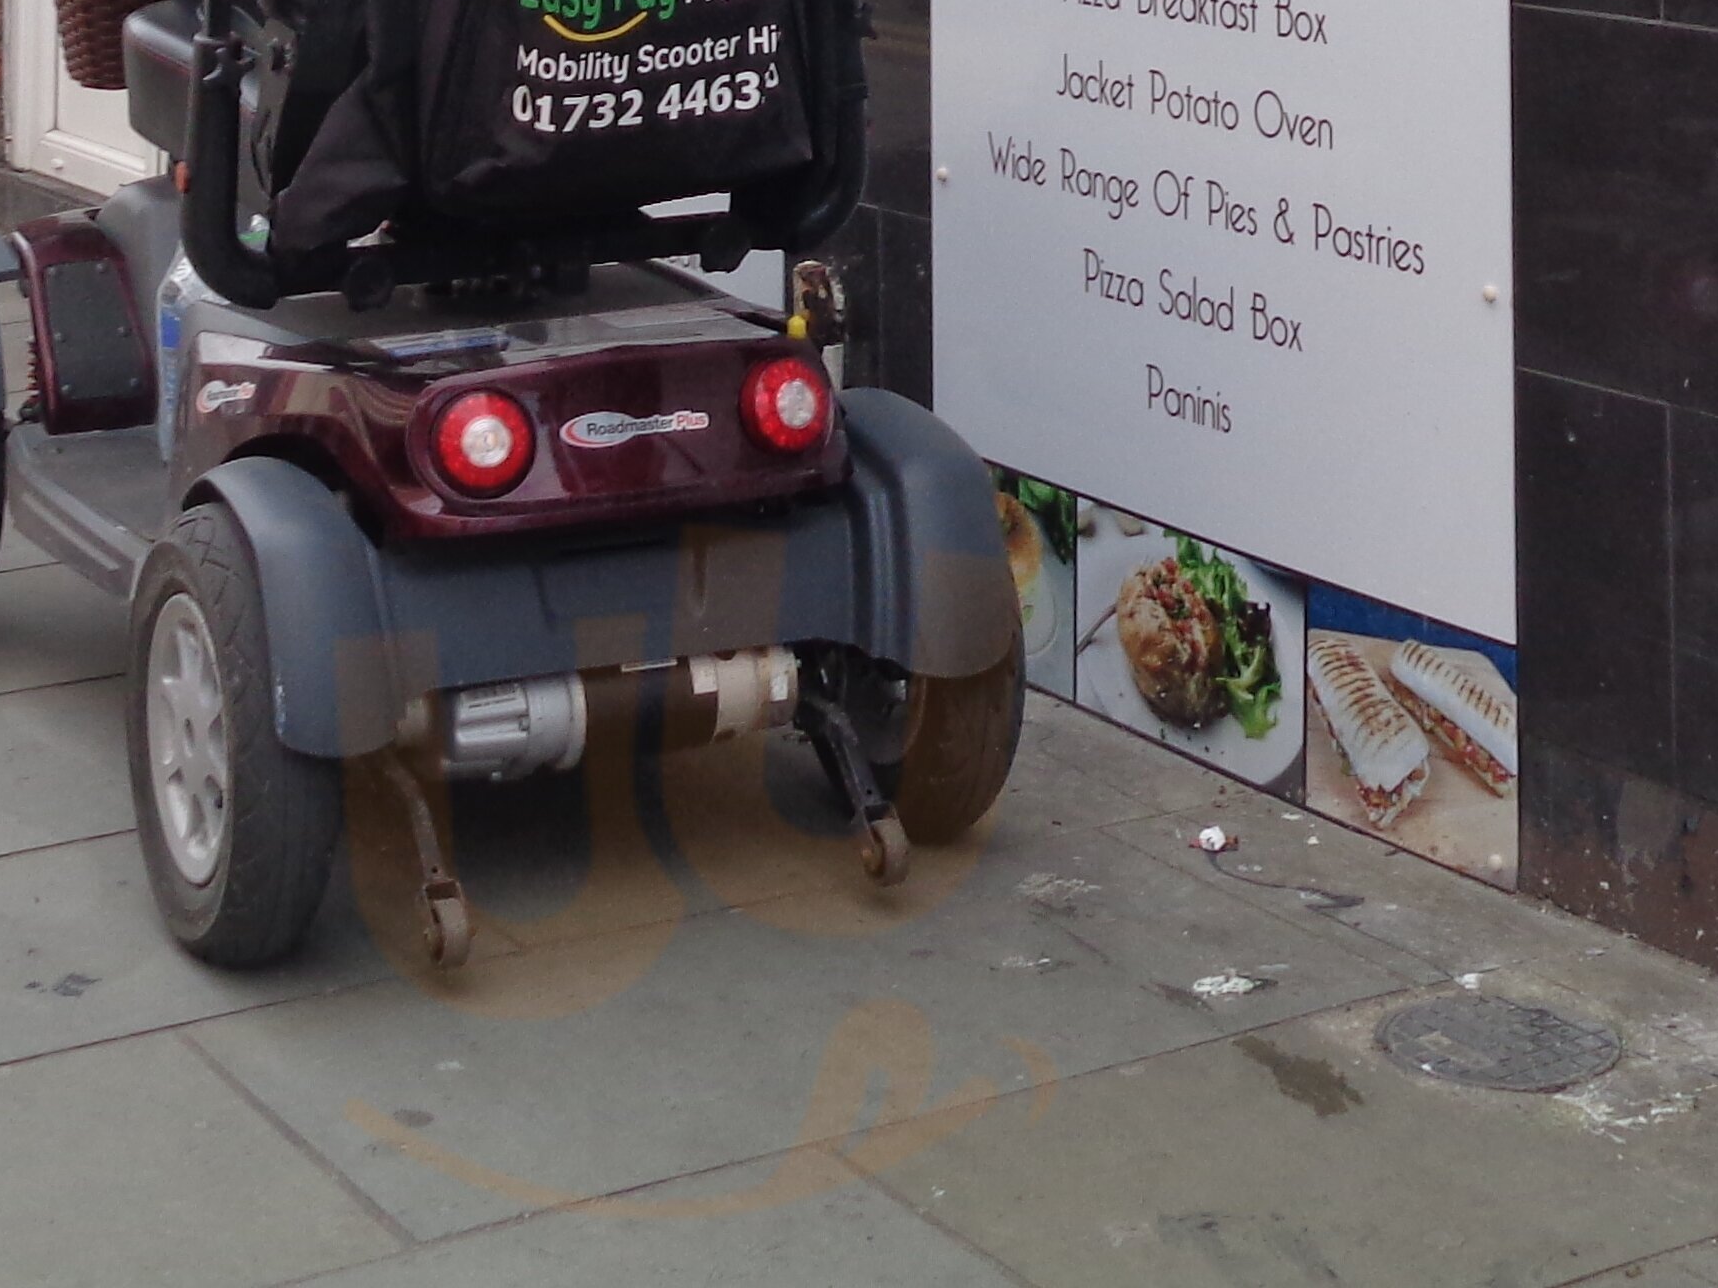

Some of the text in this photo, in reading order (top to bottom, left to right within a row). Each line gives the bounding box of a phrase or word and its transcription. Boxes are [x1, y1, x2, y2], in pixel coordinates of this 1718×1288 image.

[517, 24, 781, 84] Mobility Scooter Hi
[512, 84, 644, 134] 01732
[1056, 55, 1334, 150] Jacket Potato Oven
[988, 131, 1425, 276] Wide Range Of Pies & Pastries
[1083, 248, 1303, 352] Pizza Salad Box
[586, 414, 706, 437] Roadmaster Plus
[1146, 364, 1232, 433] Paninis
